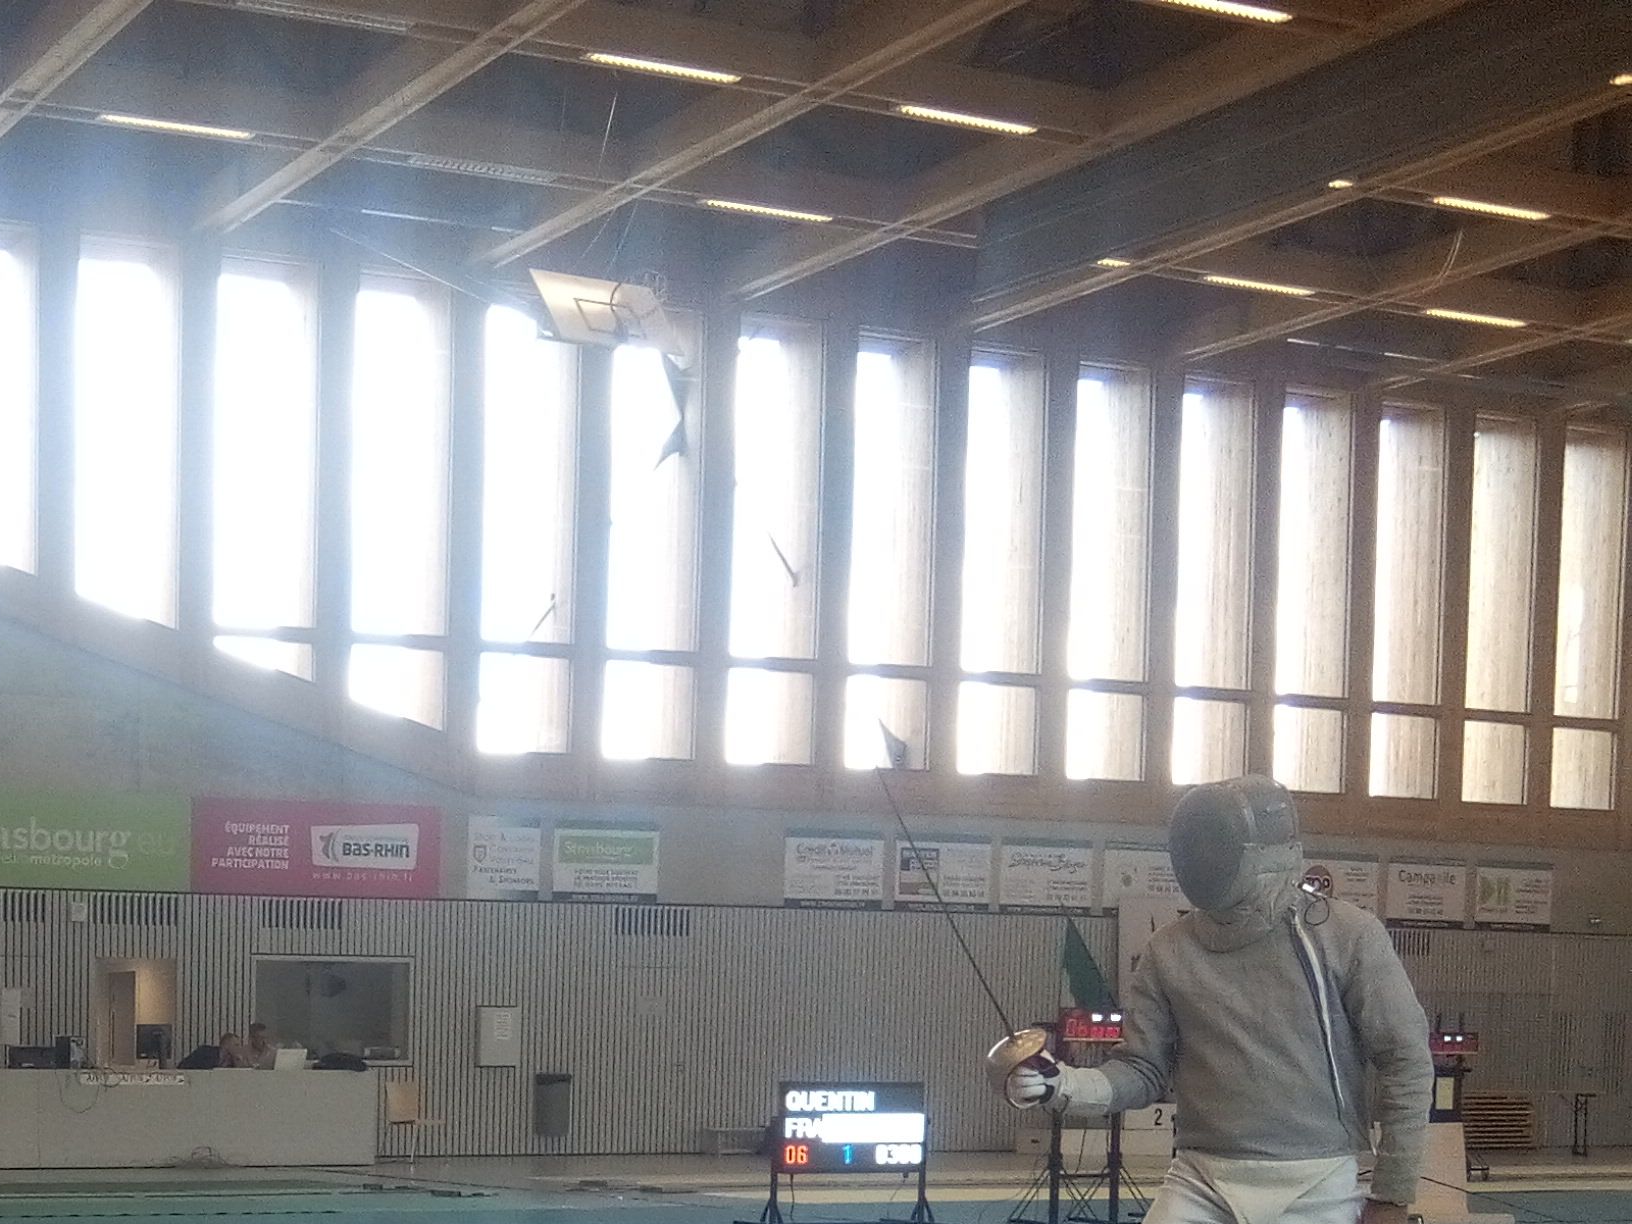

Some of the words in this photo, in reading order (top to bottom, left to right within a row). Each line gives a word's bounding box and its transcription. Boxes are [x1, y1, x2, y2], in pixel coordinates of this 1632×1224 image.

[225, 820, 290, 834] ÉQUIPEMENT
[227, 846, 255, 858] AVEC
[256, 846, 289, 859] NOTRE
[211, 858, 289, 871] PARTICIPATION
[1398, 870, 1455, 888] Campaile
[785, 1090, 875, 1111] QUENTIN
[1154, 1108, 1163, 1126] 2
[785, 1145, 809, 1165] 06
[842, 1144, 855, 1164] 1
